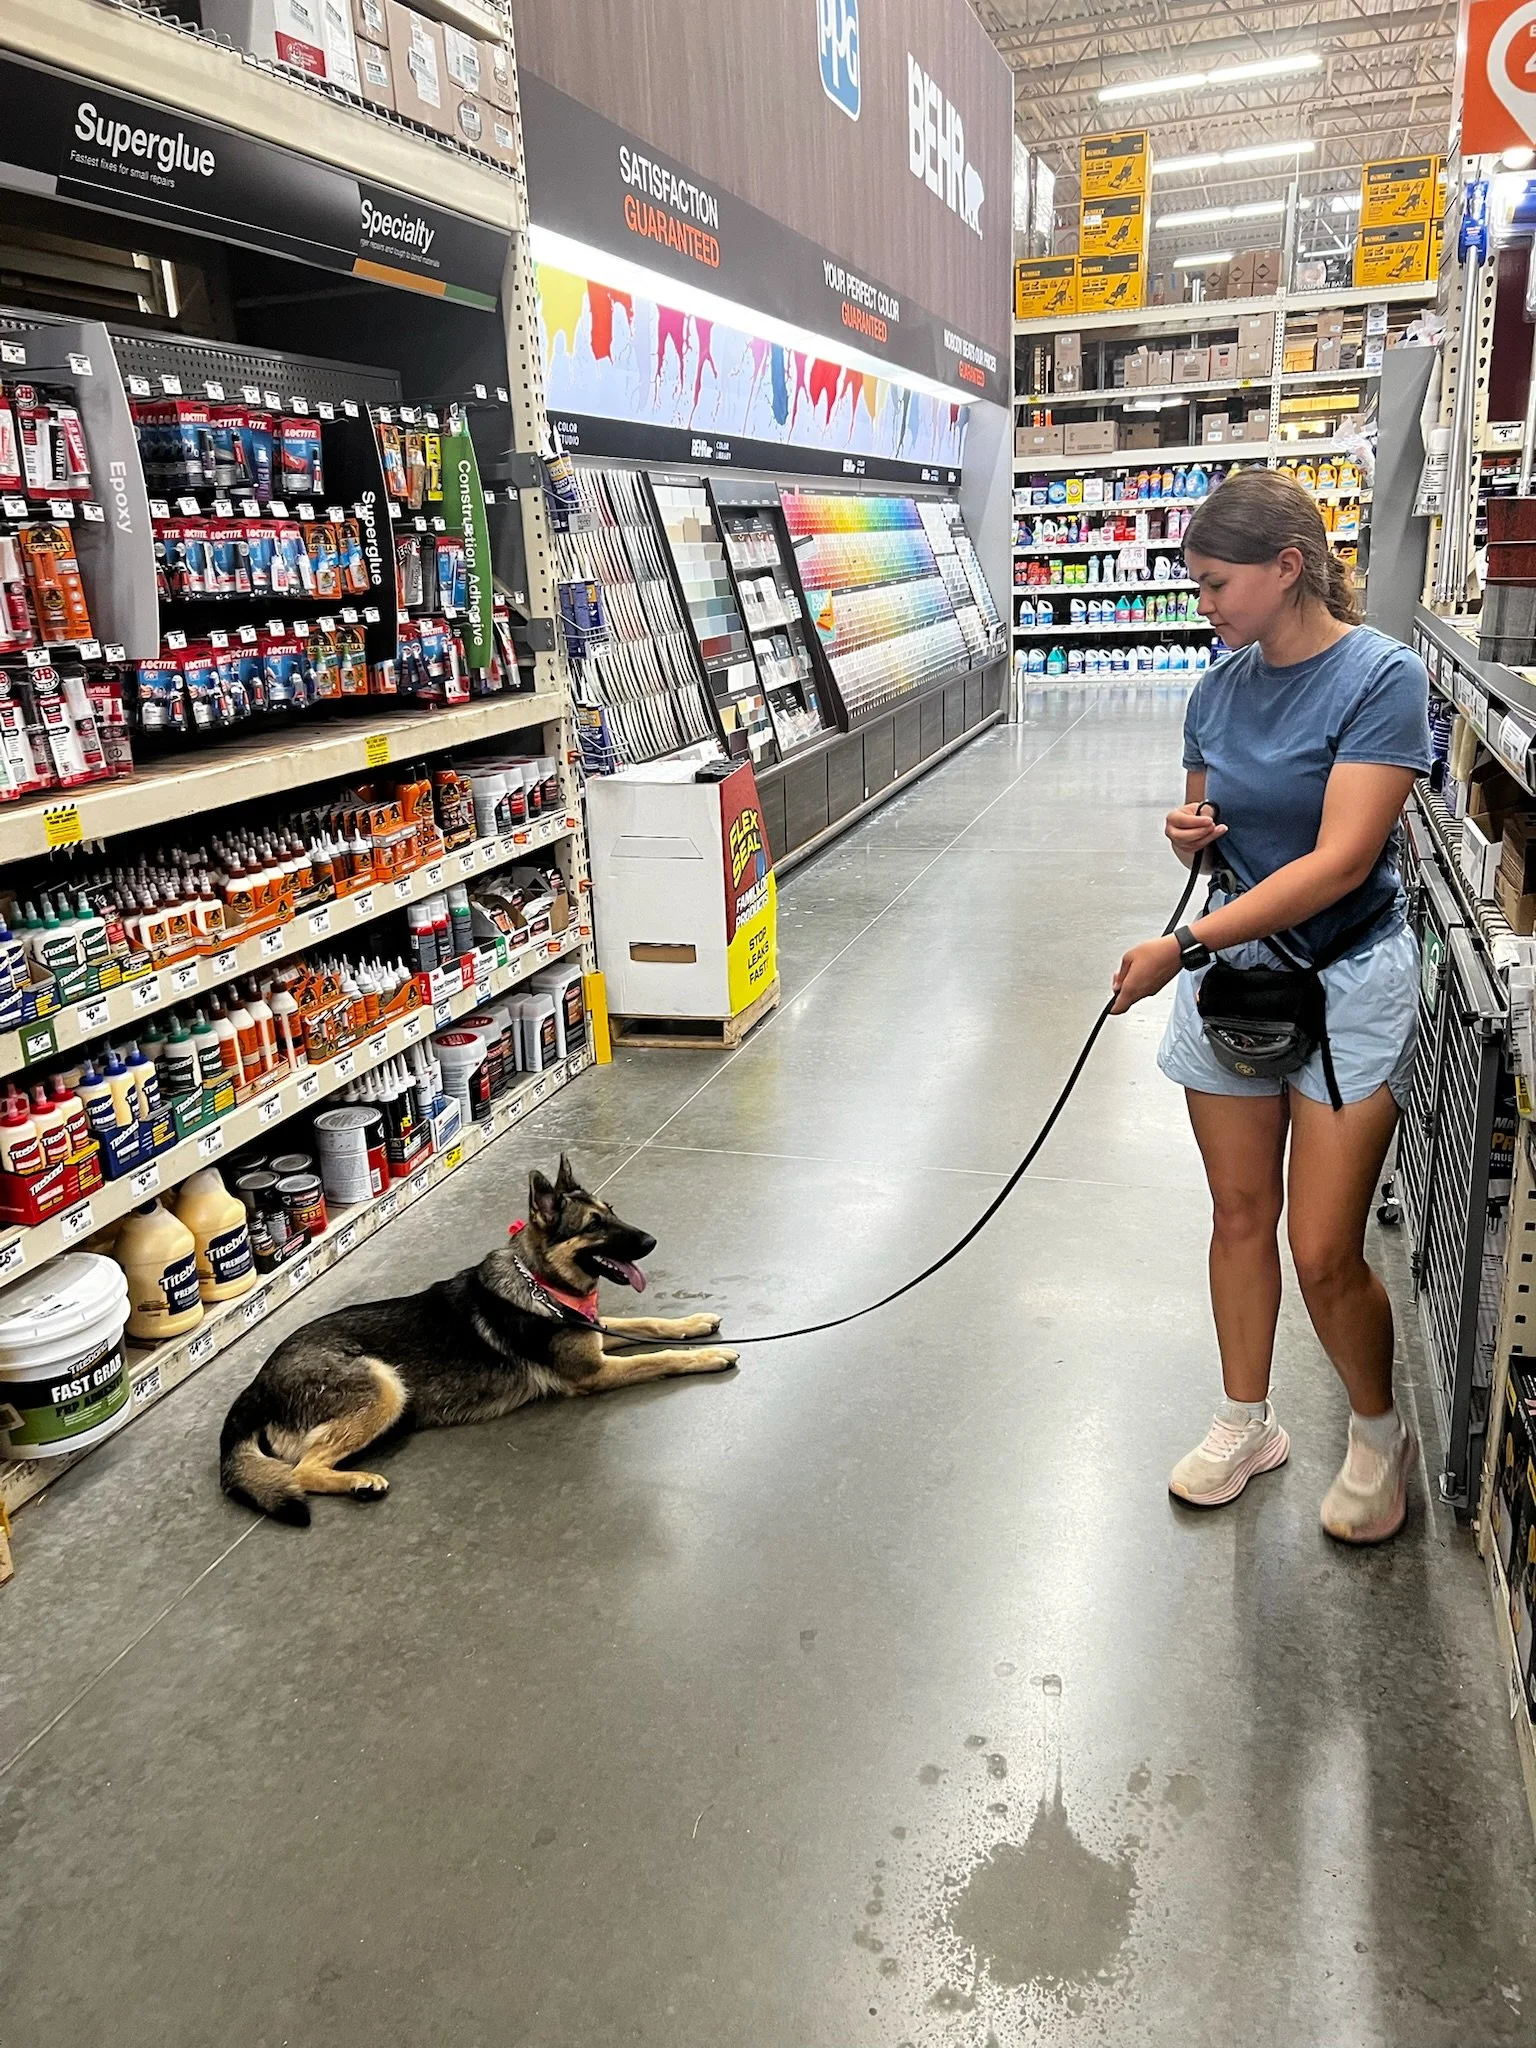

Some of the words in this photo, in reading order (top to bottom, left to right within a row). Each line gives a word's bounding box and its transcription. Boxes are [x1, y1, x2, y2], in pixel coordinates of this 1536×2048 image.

[75, 102, 215, 176] Superglue
[907, 51, 966, 225] BEHR
[70, 150, 99, 168] Fastest
[100, 158, 118, 173] fixes
[119, 164, 129, 175] for
[130, 168, 149, 181] small
[150, 173, 175, 188] repairs
[619, 146, 719, 229] SATISFACTION
[361, 199, 435, 254] Specialty
[623, 194, 720, 269] GUARANTEED
[823, 259, 846, 294] YOUR
[846, 273, 877, 310] PERFECT
[877, 291, 900, 323] COLOR
[841, 301, 888, 343] GUARANTEED
[181, 413, 208, 422] LOCTITE
[248, 420, 268, 430] TITE
[285, 429, 317, 438] LOCTITE
[557, 421, 577, 433] COLOR
[715, 441, 729, 450] COLOR
[109, 462, 133, 534] Epoxy
[162, 530, 181, 539] TITE
[211, 530, 243, 539] LOCTITE
[362, 491, 383, 585] Superglue
[141, 660, 177, 670] LOCTITE
[185, 659, 213, 669] LOCTITE
[267, 646, 298, 655] LOCTITE
[729, 809, 759, 859] FLEX
[732, 832, 761, 889] SEAL
[736, 879, 762, 913] FAMILY
[736, 895, 769, 929] PRODUCTS
[748, 941, 769, 969] LEAKS
[749, 927, 767, 950] STOP
[463, 966, 471, 980] 77
[110, 1120, 139, 1150] Titebond
[30, 1162, 64, 1196] Titebond
[68, 1339, 108, 1375] Titebond
[51, 1375, 91, 1404] FAST
[93, 1353, 122, 1387] GRAB
